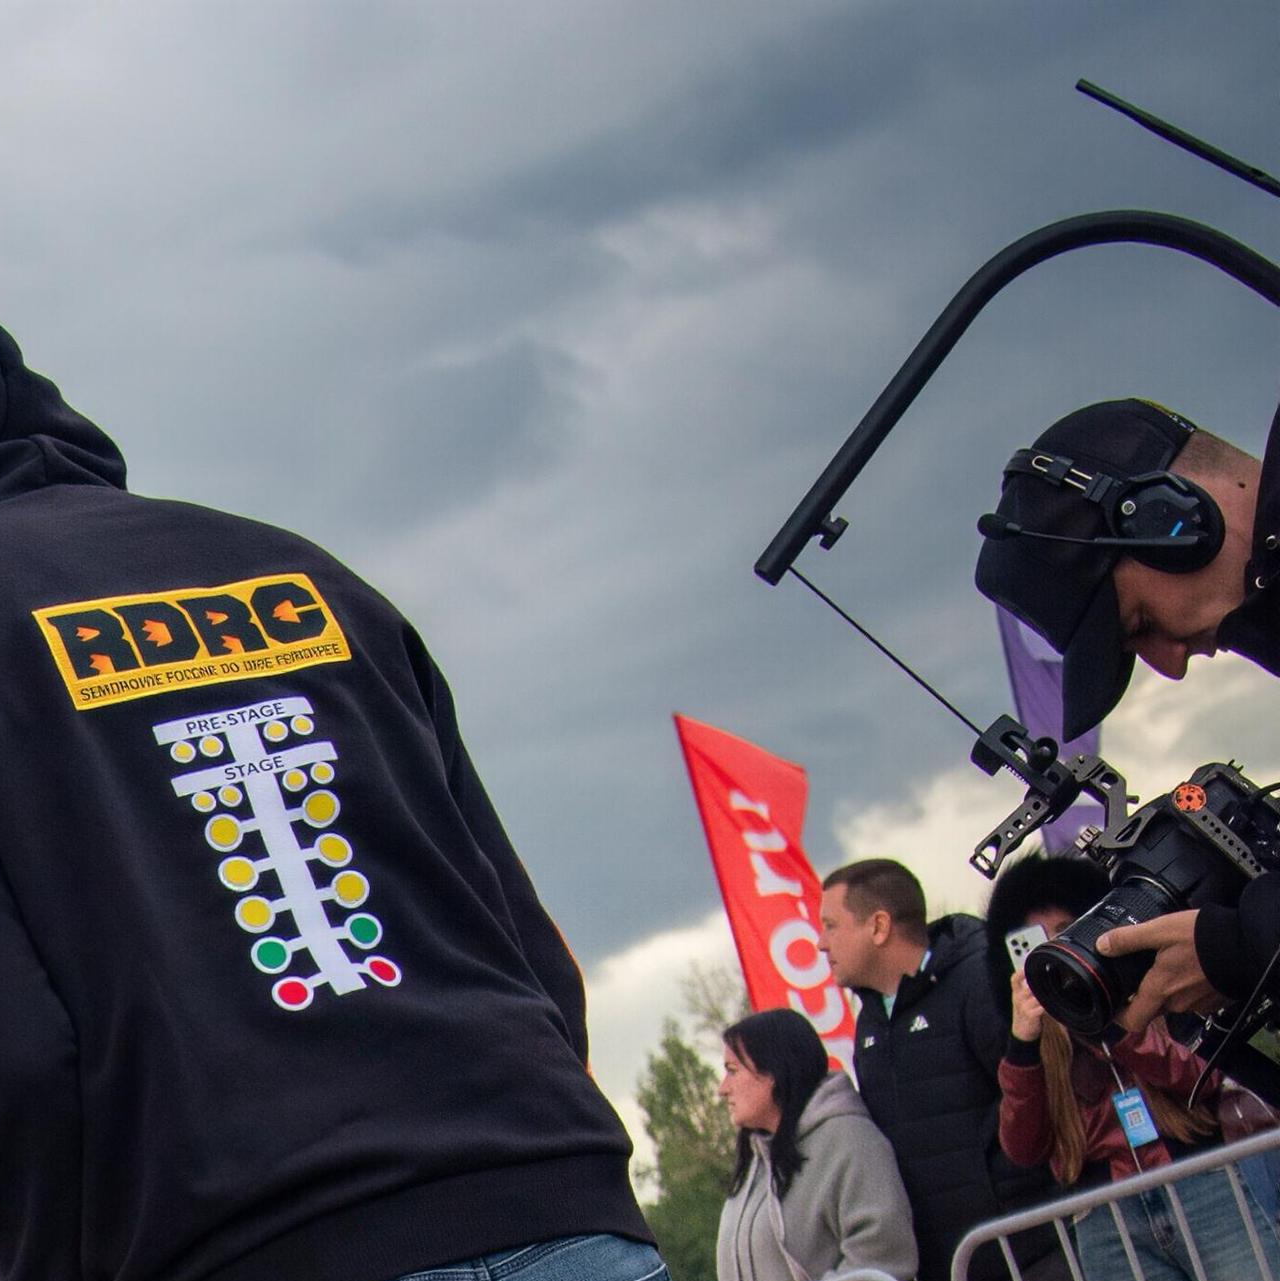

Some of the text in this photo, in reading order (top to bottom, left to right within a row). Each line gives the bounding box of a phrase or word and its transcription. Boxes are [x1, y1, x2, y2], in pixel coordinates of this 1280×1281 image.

[46, 581, 328, 680] RDRC
[186, 702, 286, 735] PRE-STAGE
[224, 756, 285, 781] STAGE
